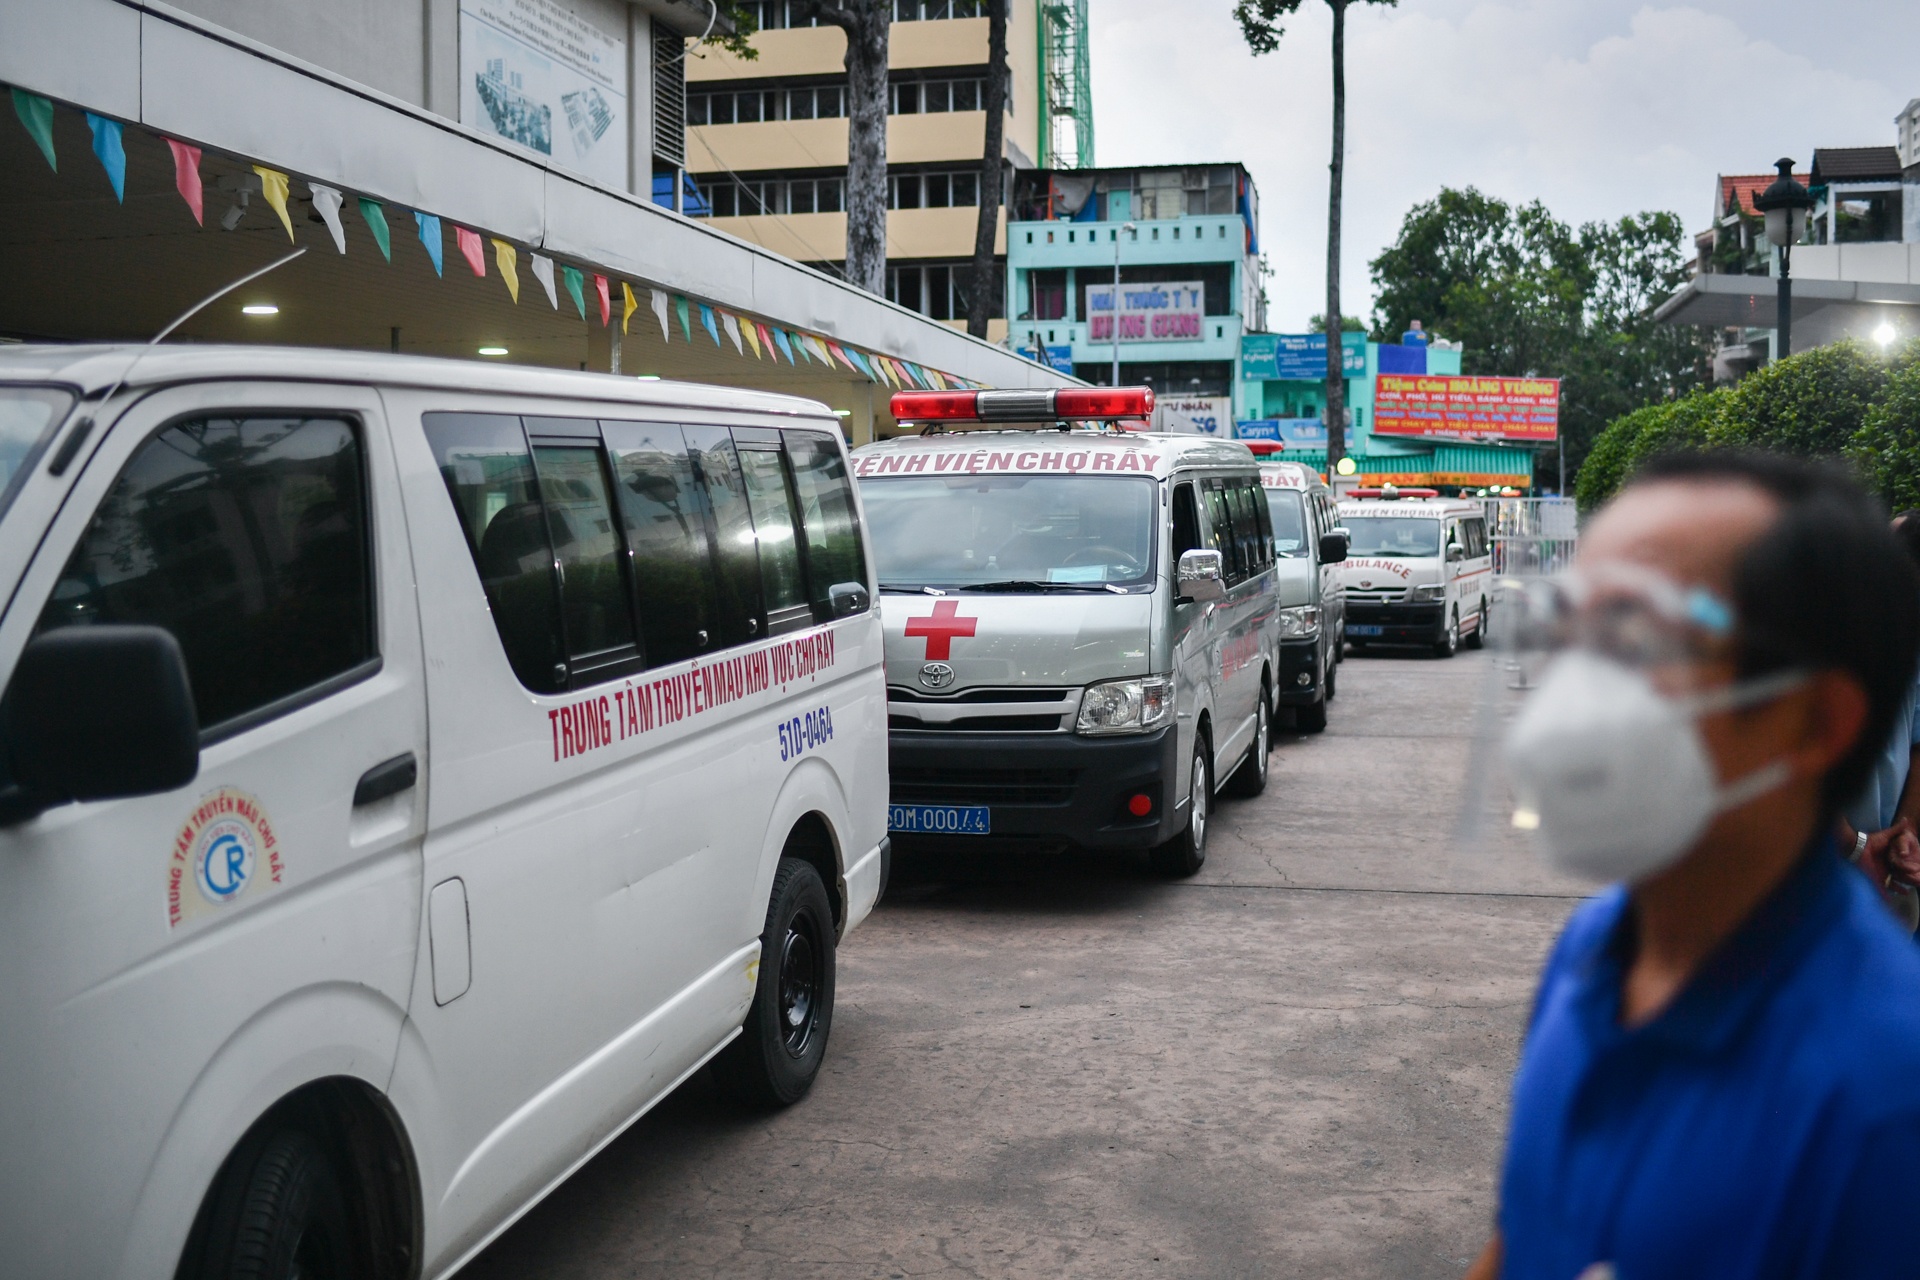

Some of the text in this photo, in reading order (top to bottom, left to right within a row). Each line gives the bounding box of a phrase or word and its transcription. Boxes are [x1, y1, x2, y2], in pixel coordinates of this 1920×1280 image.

[1151, 314, 1200, 339] GIANG
[933, 450, 1014, 474] VIỆN
[1015, 450, 1089, 474] CHỢ
[1091, 447, 1161, 472] RẪY
[548, 695, 612, 762] TRUNG
[615, 679, 654, 740] TÂM
[653, 658, 714, 727] TRUYỀN
[744, 649, 769, 696] KHU
[778, 705, 833, 762] 51D-0464
[168, 867, 183, 928] TRUNG
